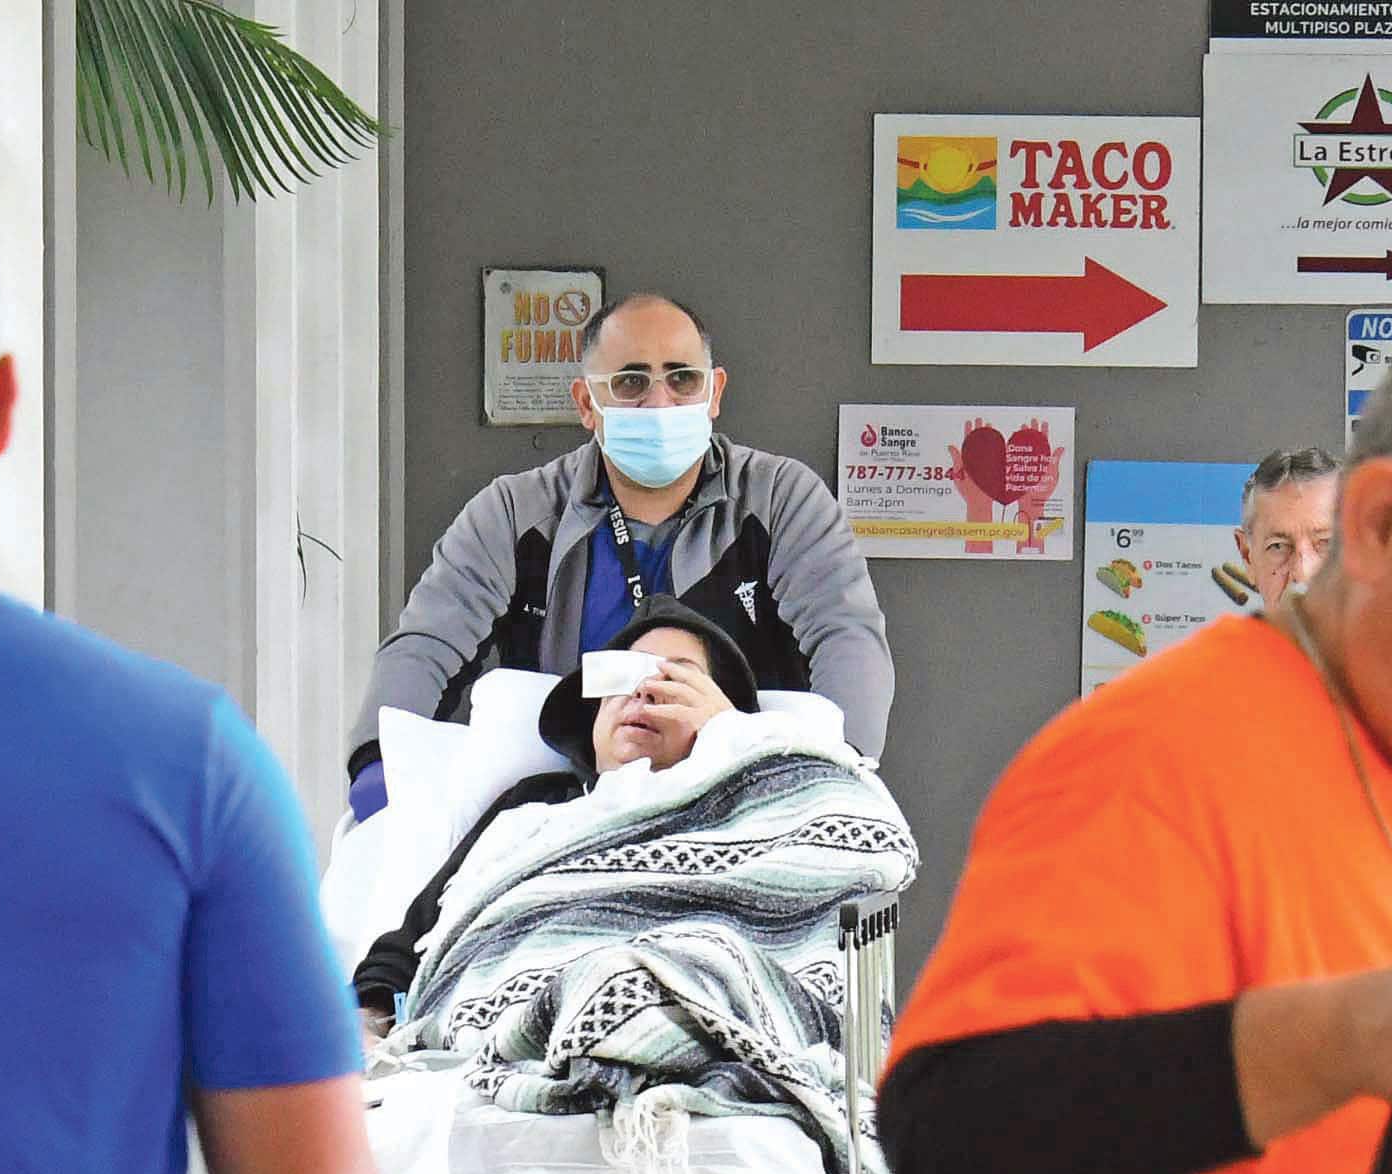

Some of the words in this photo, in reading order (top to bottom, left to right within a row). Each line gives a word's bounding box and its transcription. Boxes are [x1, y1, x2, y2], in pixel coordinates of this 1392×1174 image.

[1265, 22, 1350, 35] MULTIPISO
[1298, 140, 1328, 162] La
[1009, 139, 1172, 191] TACO
[1009, 192, 1172, 230] MAKER
[1313, 218, 1352, 233] mejor
[514, 291, 550, 326] NO
[880, 426, 913, 437] Banco
[880, 437, 916, 449] Sangre
[847, 485, 882, 494] Lunes
[896, 485, 952, 496] Domingo
